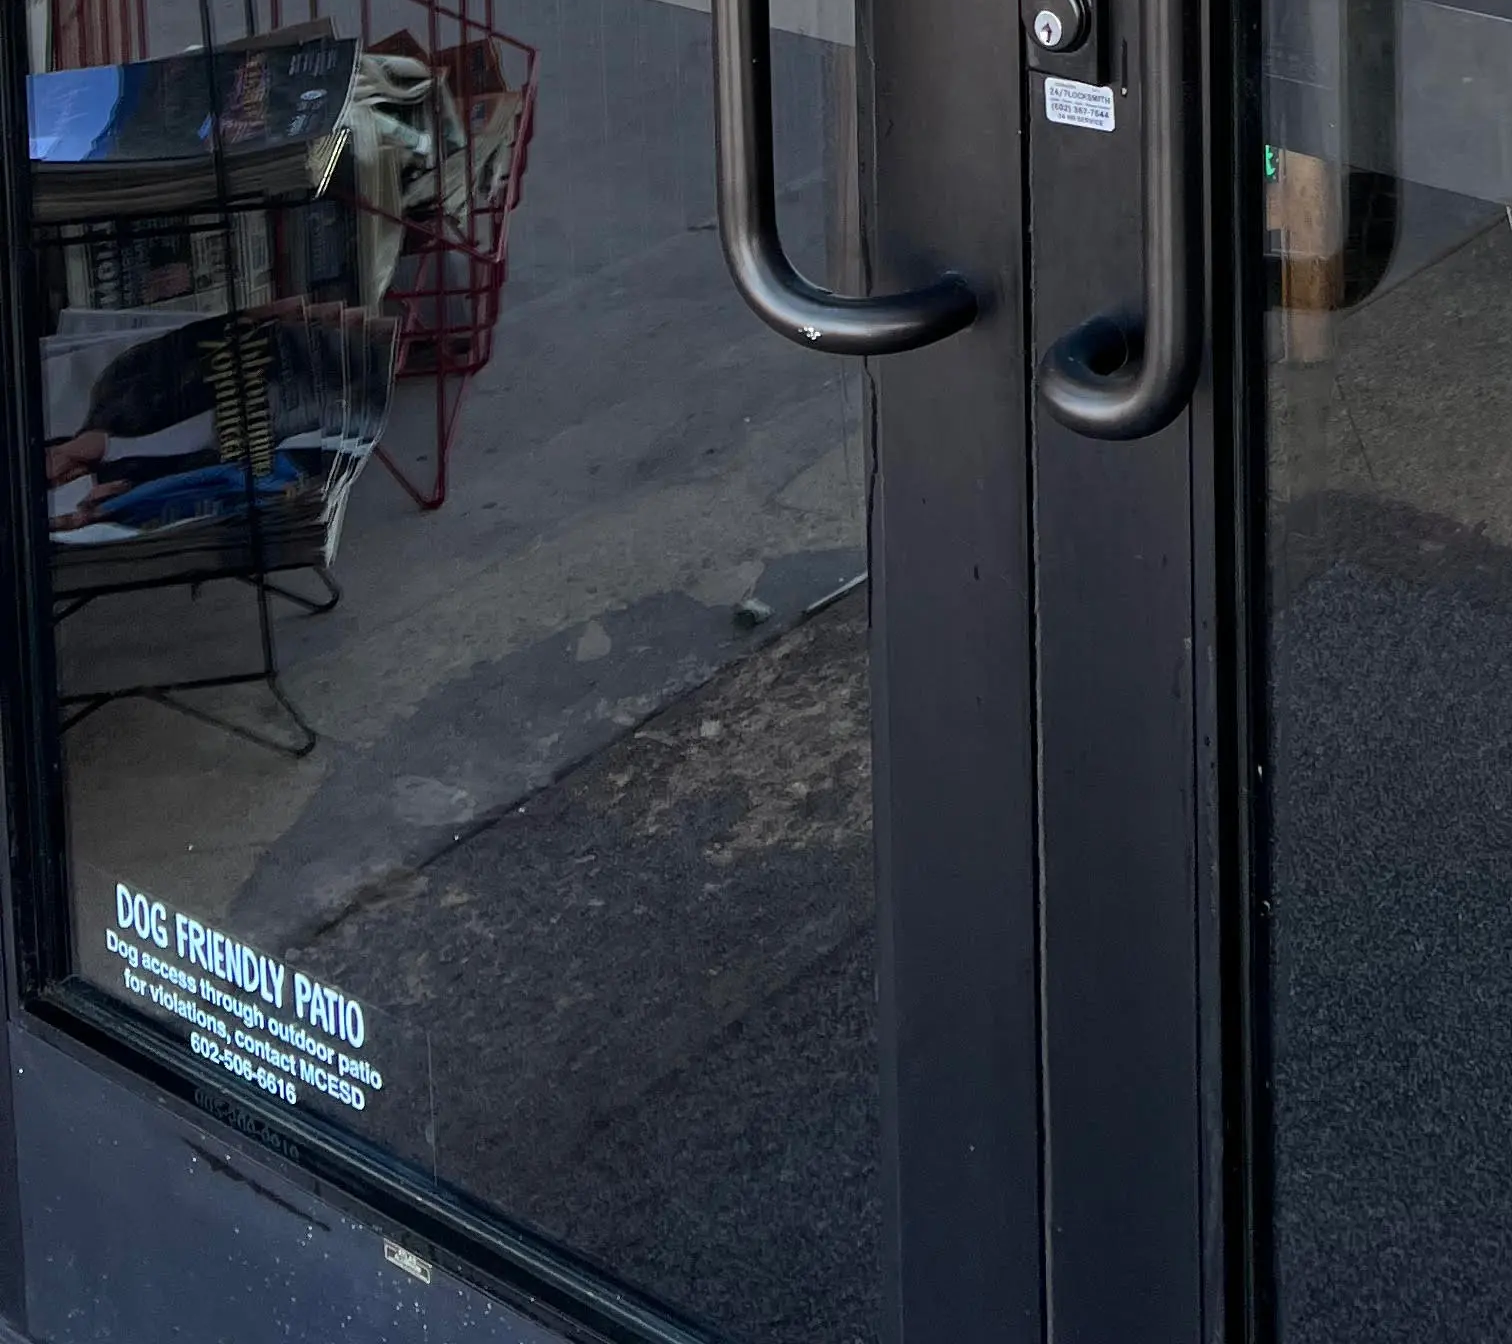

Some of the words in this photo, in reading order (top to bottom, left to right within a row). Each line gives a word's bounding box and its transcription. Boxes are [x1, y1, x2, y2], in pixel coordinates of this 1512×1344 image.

[106, 928, 139, 969] Dog
[142, 949, 197, 996] access
[200, 977, 265, 1031] through
[268, 1017, 336, 1064] outdoor
[338, 1051, 383, 1091] patio
[115, 883, 169, 949] DOG
[175, 912, 286, 1010] FRIENDLY
[294, 972, 365, 1050] PATIO
[123, 969, 149, 997] for
[150, 987, 233, 1045] violations,
[234, 1029, 297, 1077] contact
[300, 1059, 366, 1112] MCESD
[189, 1031, 298, 1106] 602-506-6616
